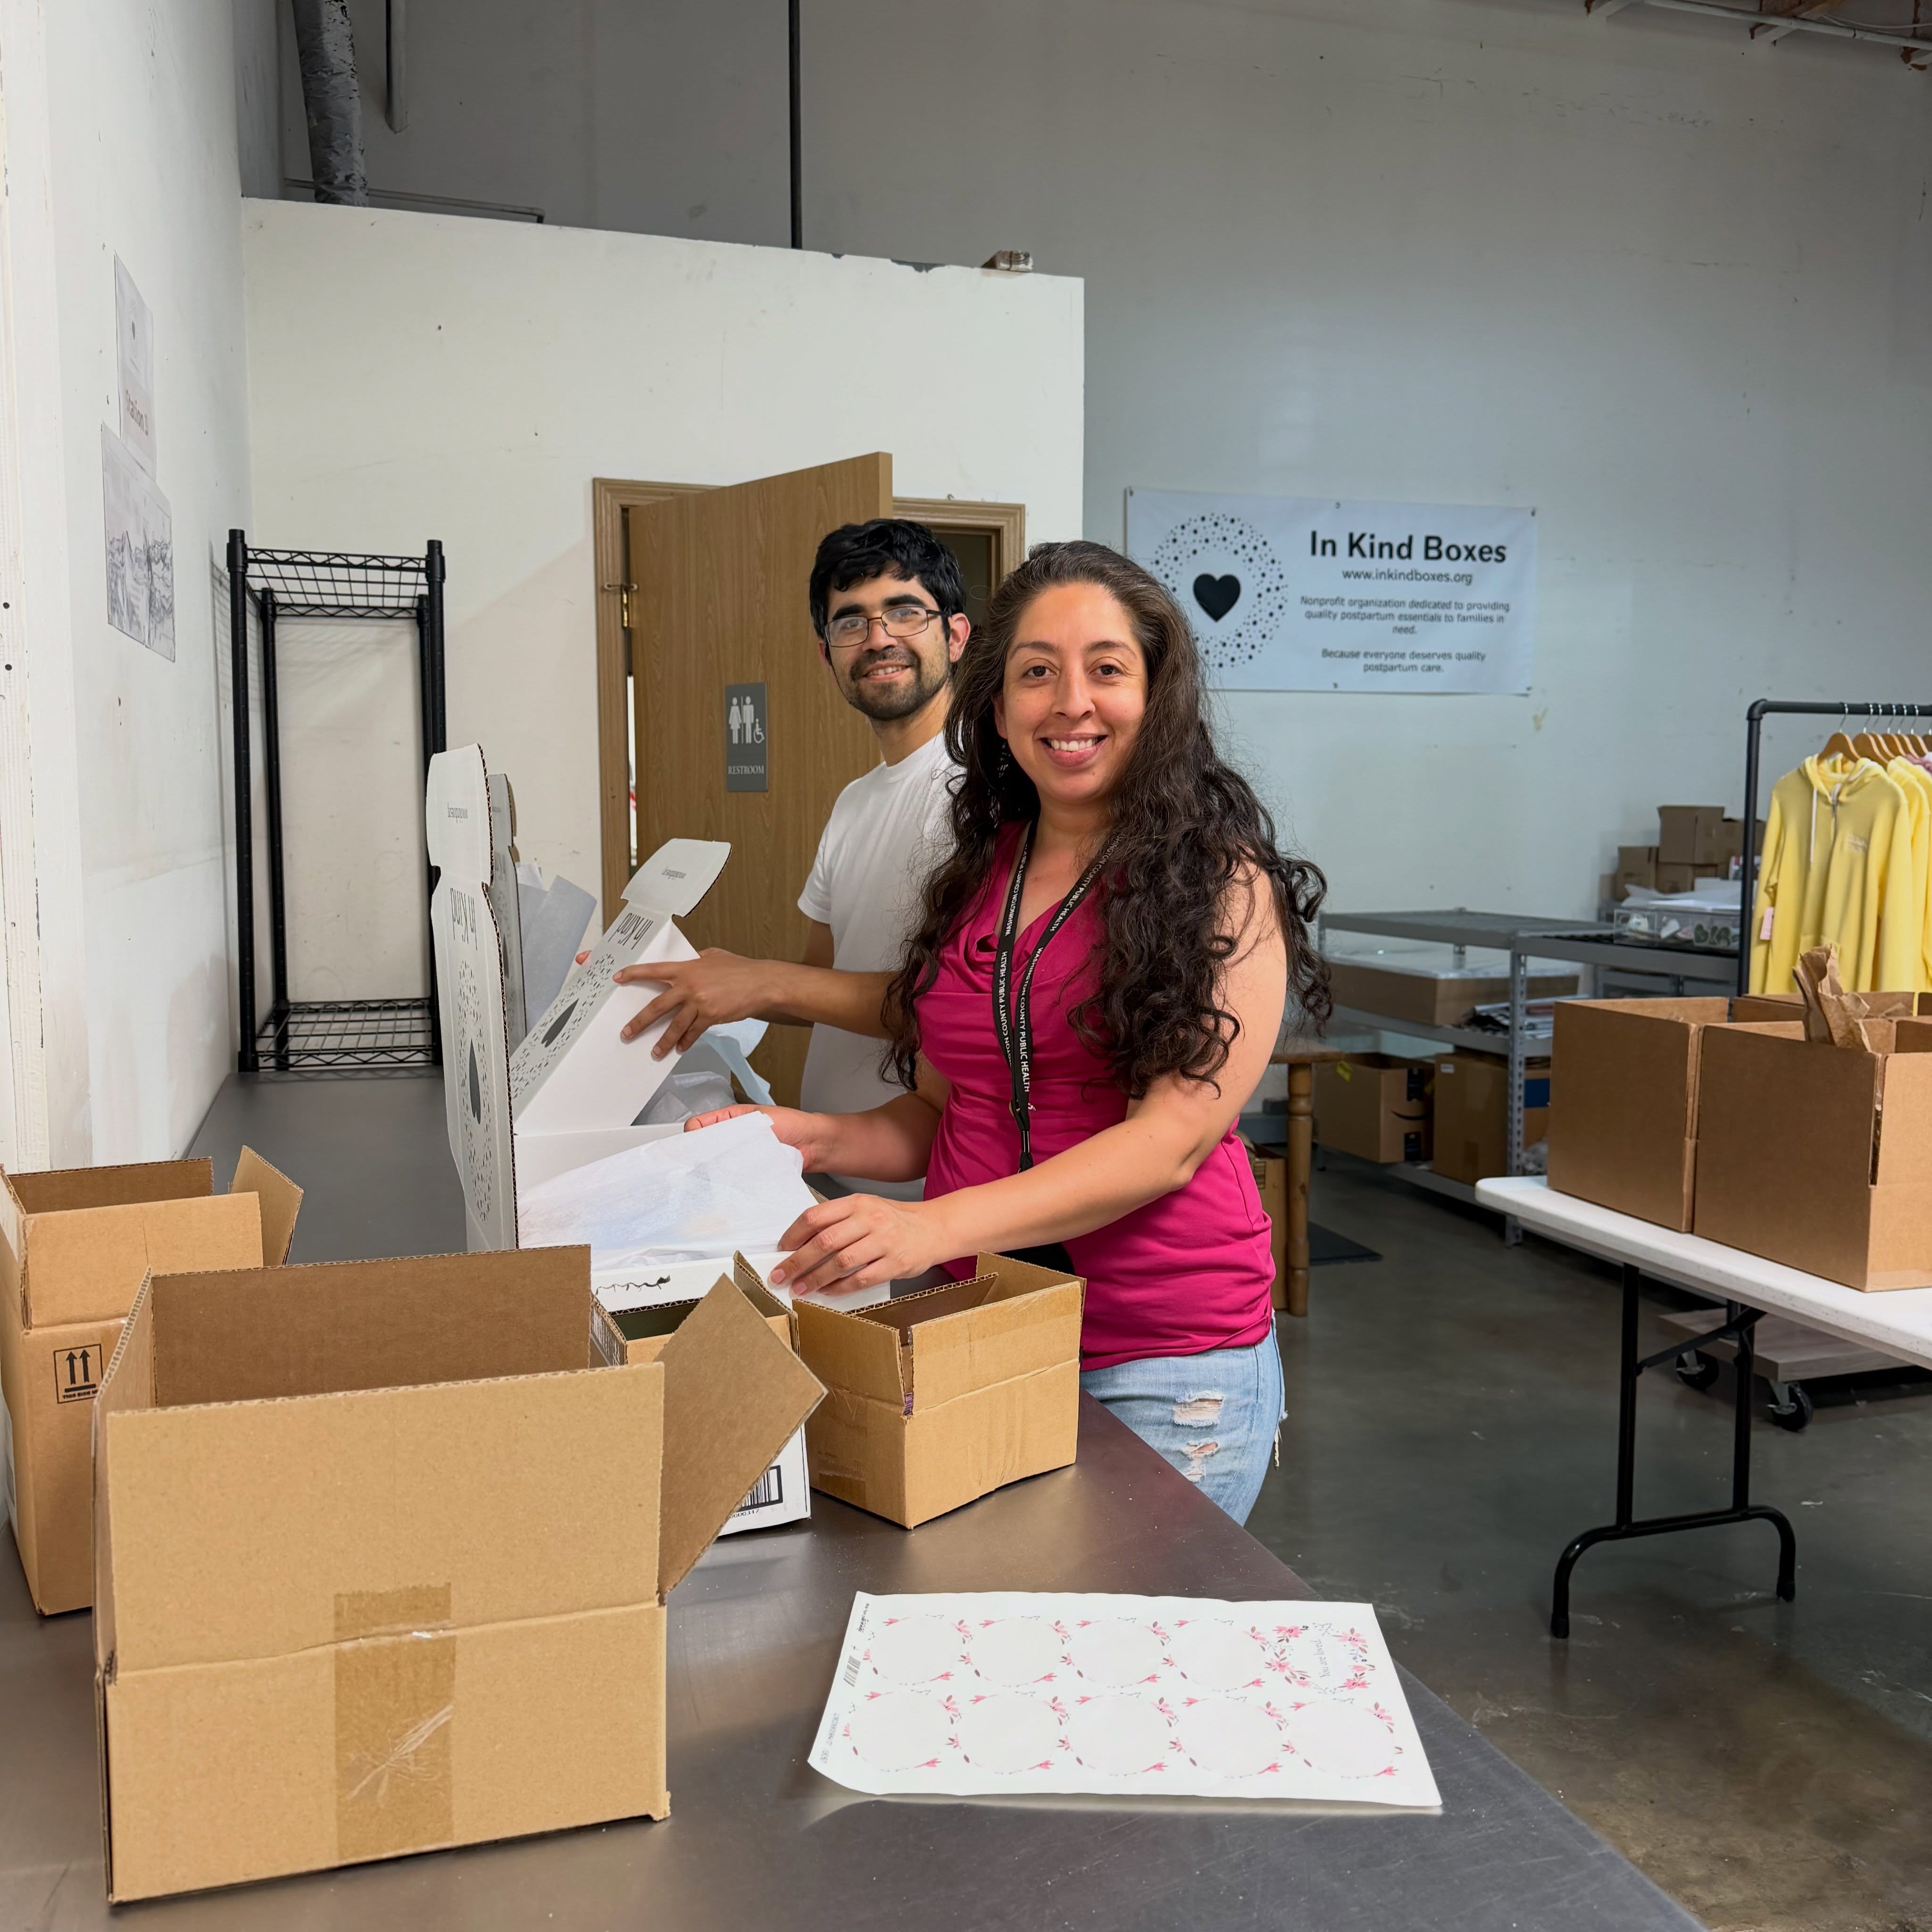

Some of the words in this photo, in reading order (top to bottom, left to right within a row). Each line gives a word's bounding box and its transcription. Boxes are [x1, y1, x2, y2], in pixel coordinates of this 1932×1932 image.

[1311, 530, 1336, 557] In
[1348, 532, 1413, 560] Kind
[1424, 535, 1507, 564] Boxes
[1342, 568, 1473, 586] www.inkindboxes.org
[1300, 595, 1345, 609] Nonprofit
[1348, 597, 1405, 610] organization
[1408, 599, 1451, 610] dedicated
[1454, 600, 1463, 610] to
[1466, 600, 1510, 613] providing
[1305, 609, 1337, 621] quality
[1341, 611, 1395, 622] postpartum
[1398, 612, 1441, 623] essentials
[1444, 613, 1454, 623] to
[1457, 613, 1494, 624] families
[1497, 613, 1504, 624] in
[1392, 625, 1417, 635] need.
[1321, 649, 1360, 659] Because
[1363, 650, 1406, 661] everyone
[1409, 650, 1452, 661] deserves
[1455, 651, 1486, 662] quality
[1363, 662, 1417, 673] postpartum
[1421, 663, 1444, 673] care.
[728, 765, 765, 774] RESTROOM
[1082, 864, 1102, 888] COUNTY
[1005, 894, 1017, 936] WASHINGTON
[1014, 870, 1023, 893] COUNTY
[1066, 887, 1085, 908] PUBLIC
[450, 887, 469, 945] Kind
[468, 895, 478, 951] In
[1050, 908, 1070, 931] HEALTH
[608, 913, 644, 946] Kind
[631, 919, 654, 950] In
[1000, 951, 1008, 977] HEALTH
[1021, 947, 1043, 996] WASHINGTON
[999, 1004, 1008, 1036] COUNTY
[1020, 1031, 1028, 1060] PUBLIC
[1021, 1061, 1030, 1092] HEALTH
[1319, 1657, 1327, 1665] are
[1320, 1667, 1330, 1677] You
